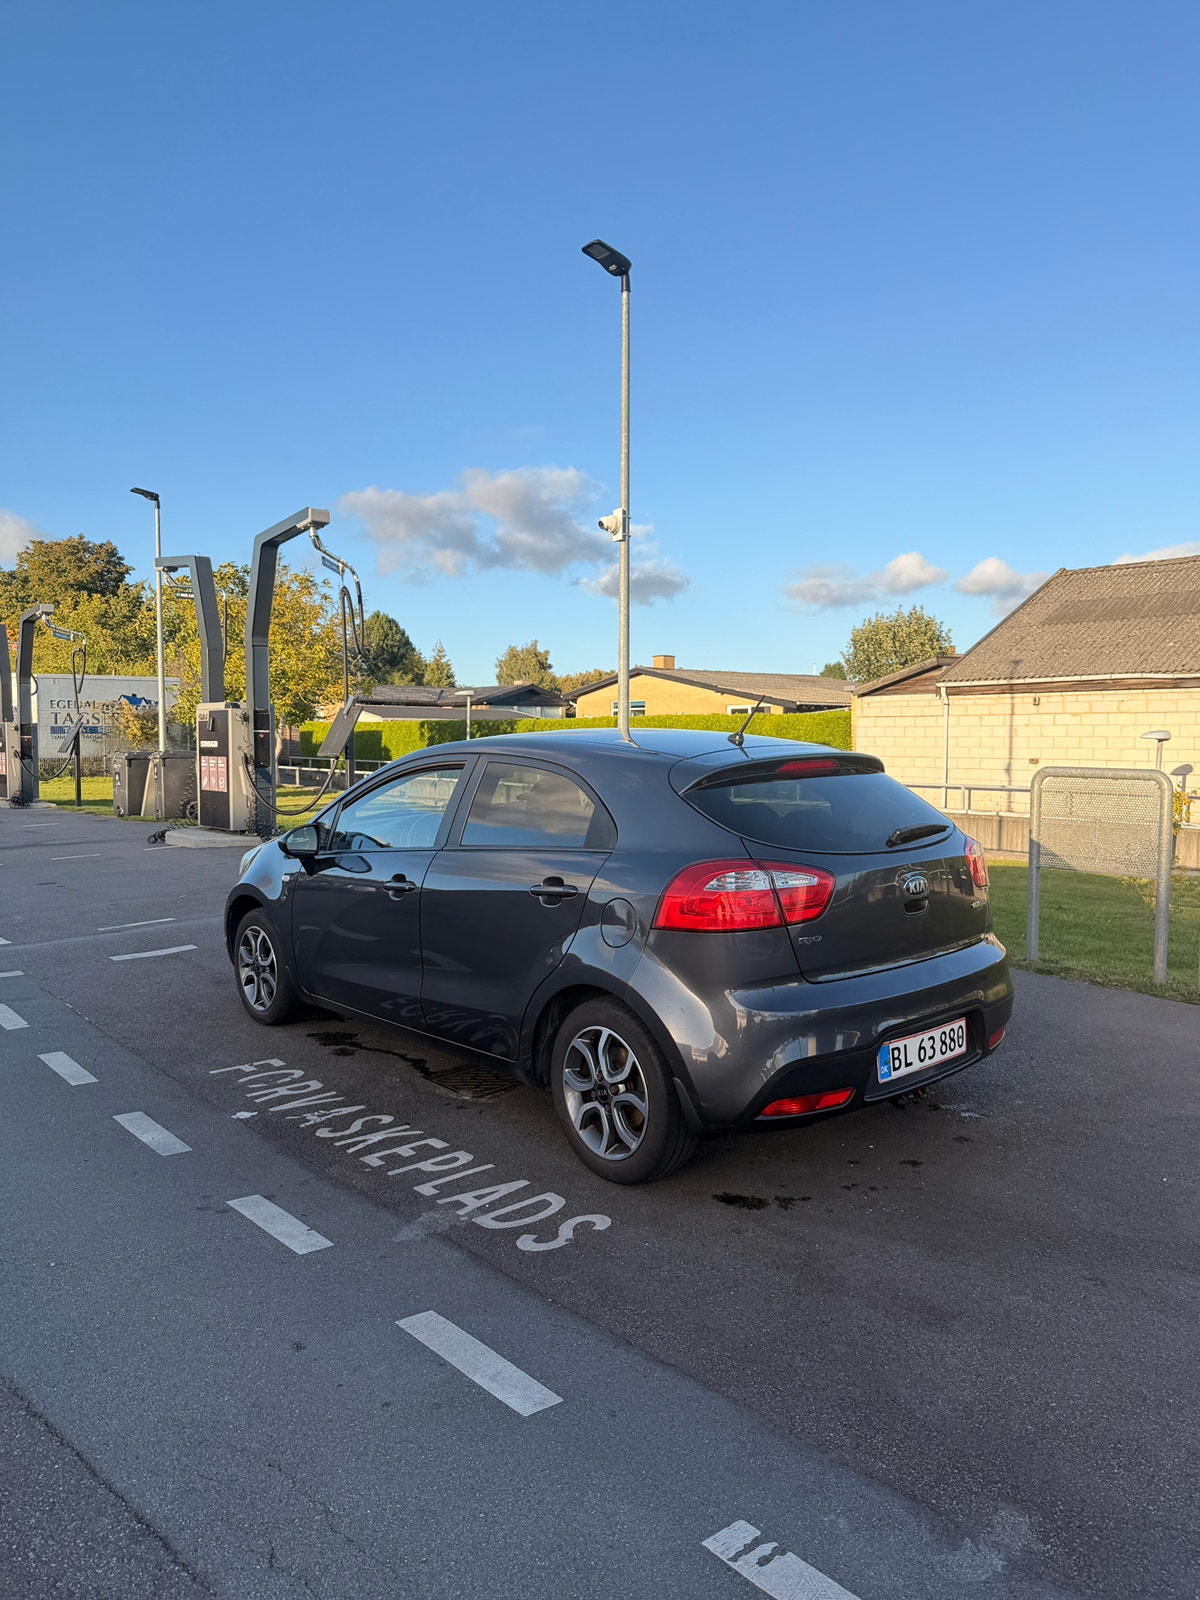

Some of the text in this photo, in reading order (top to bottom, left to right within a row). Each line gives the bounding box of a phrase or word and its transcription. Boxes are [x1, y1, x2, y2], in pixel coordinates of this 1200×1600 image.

[909, 880, 926, 893] KIA
[891, 1025, 964, 1072] BL 63 880
[880, 1065, 889, 1074] DK
